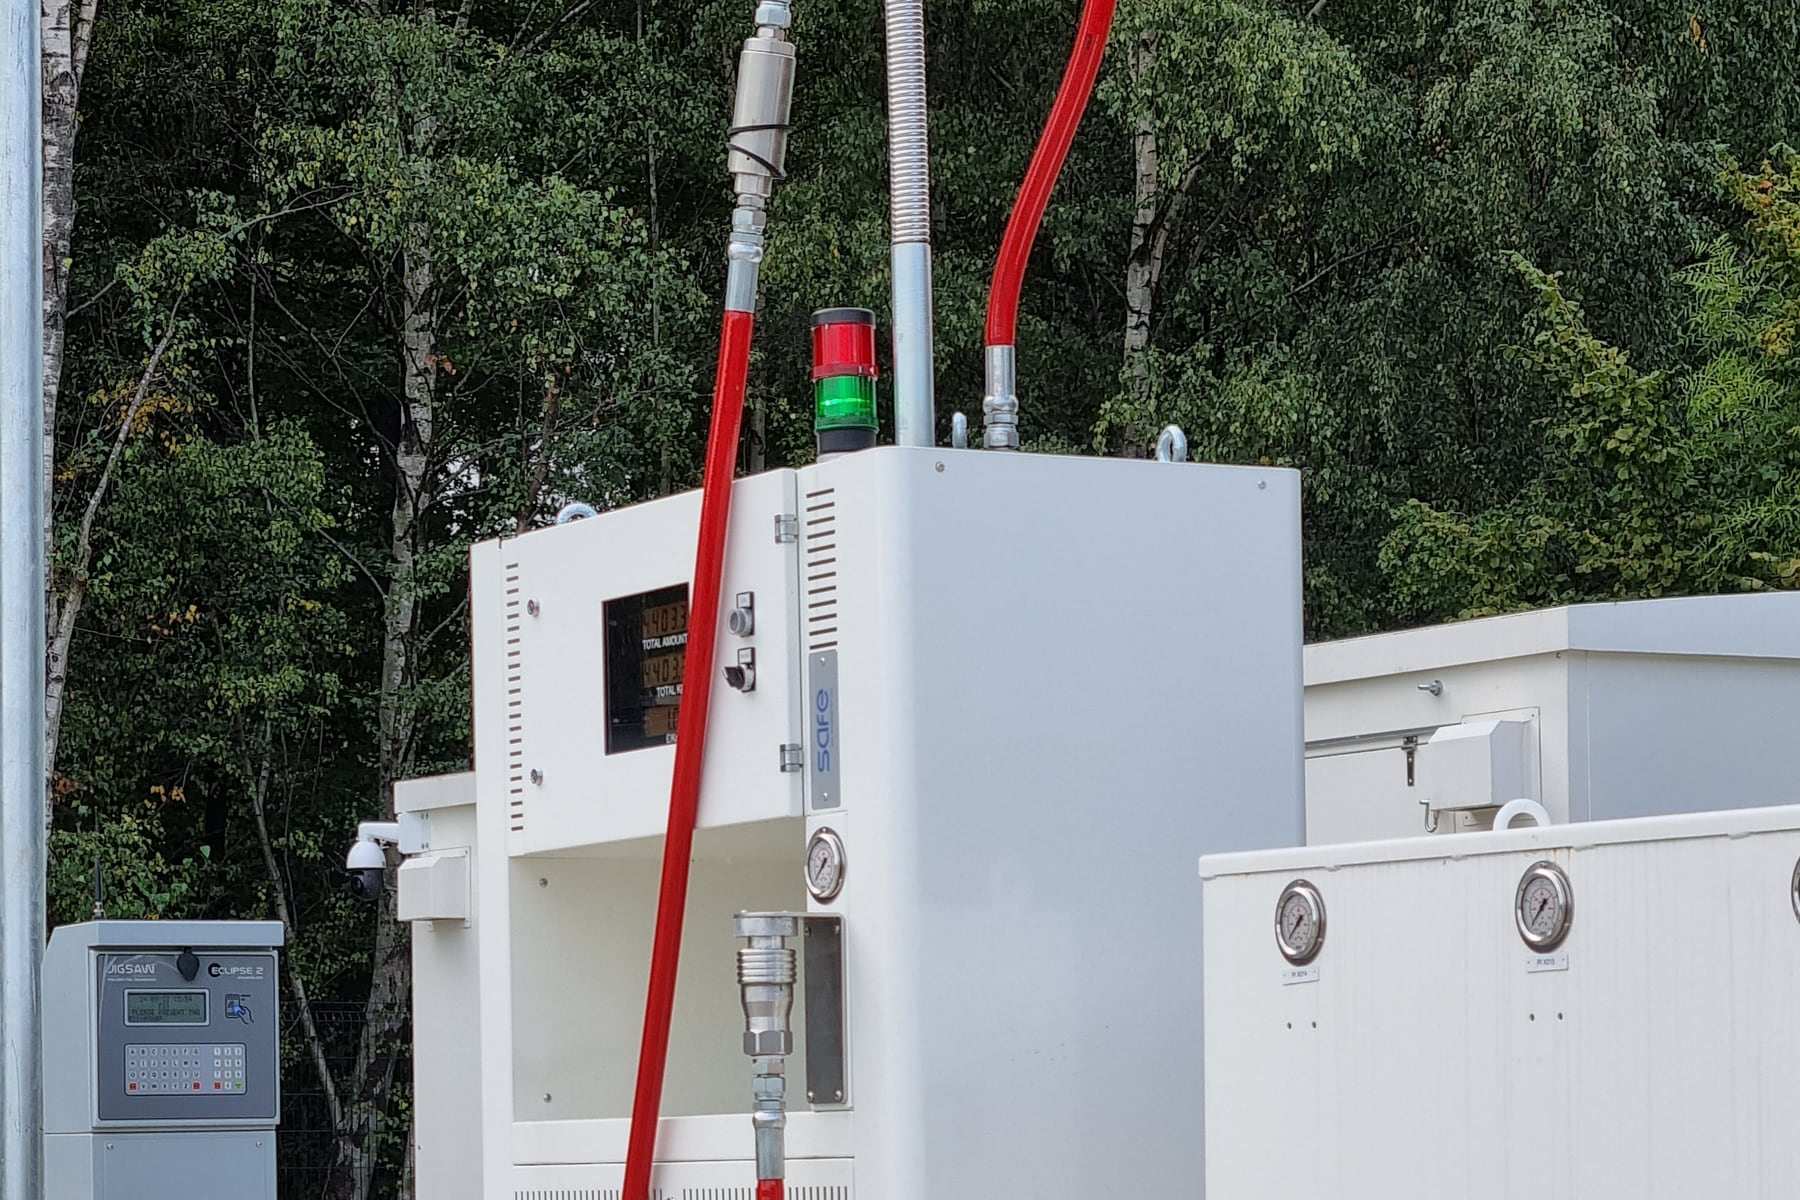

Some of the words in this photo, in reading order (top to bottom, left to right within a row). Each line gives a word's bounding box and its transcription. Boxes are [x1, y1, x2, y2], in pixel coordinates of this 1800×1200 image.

[641, 635, 661, 650] TOTAL
[661, 631, 688, 648] AMOUNT
[655, 685, 676, 699] TOTAL
[816, 688, 830, 773] safe
[107, 963, 156, 975] JIGSAW
[209, 965, 253, 976] ECLIPSE
[255, 966, 264, 975] 2
